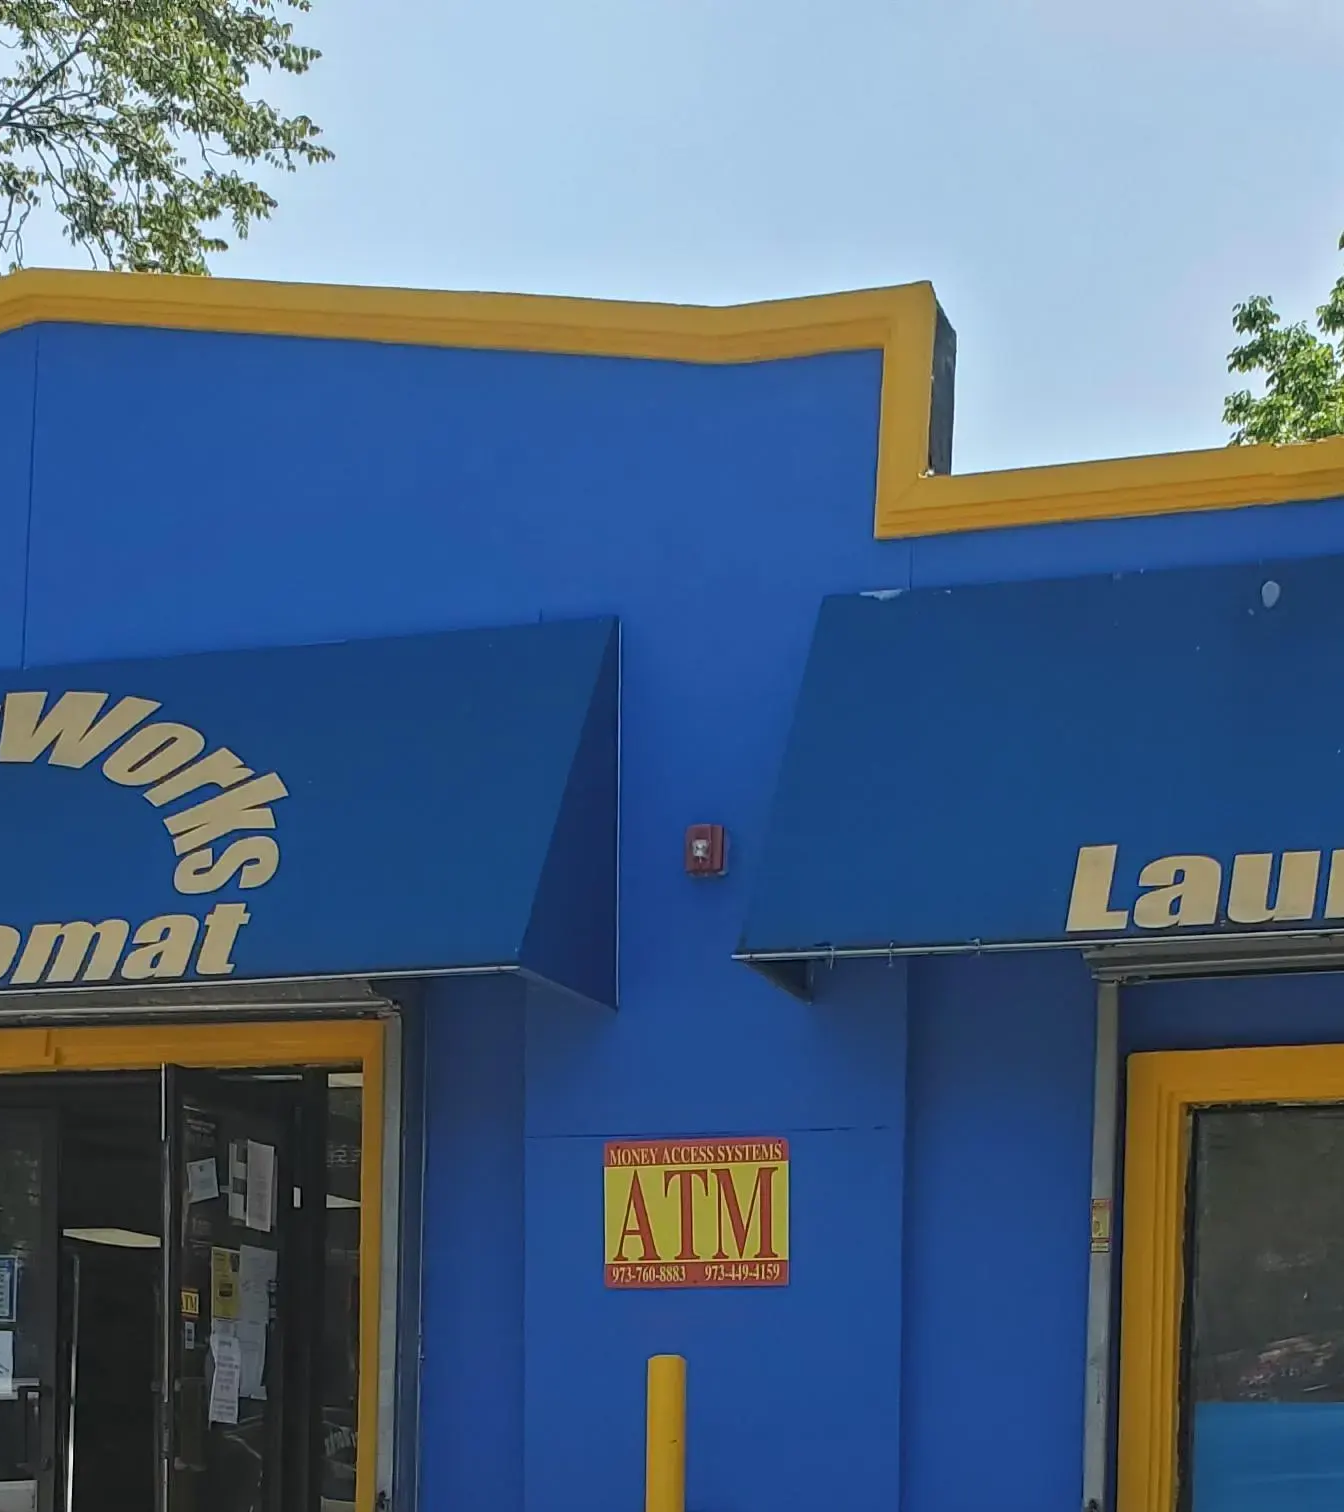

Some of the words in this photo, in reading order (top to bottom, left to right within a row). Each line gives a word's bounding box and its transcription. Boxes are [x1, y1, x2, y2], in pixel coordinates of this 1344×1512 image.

[609, 1148, 659, 1166] MONEY
[662, 1145, 714, 1164] ACCESS
[717, 1143, 782, 1162] SYSTEMS
[612, 1167, 779, 1262] ATM
